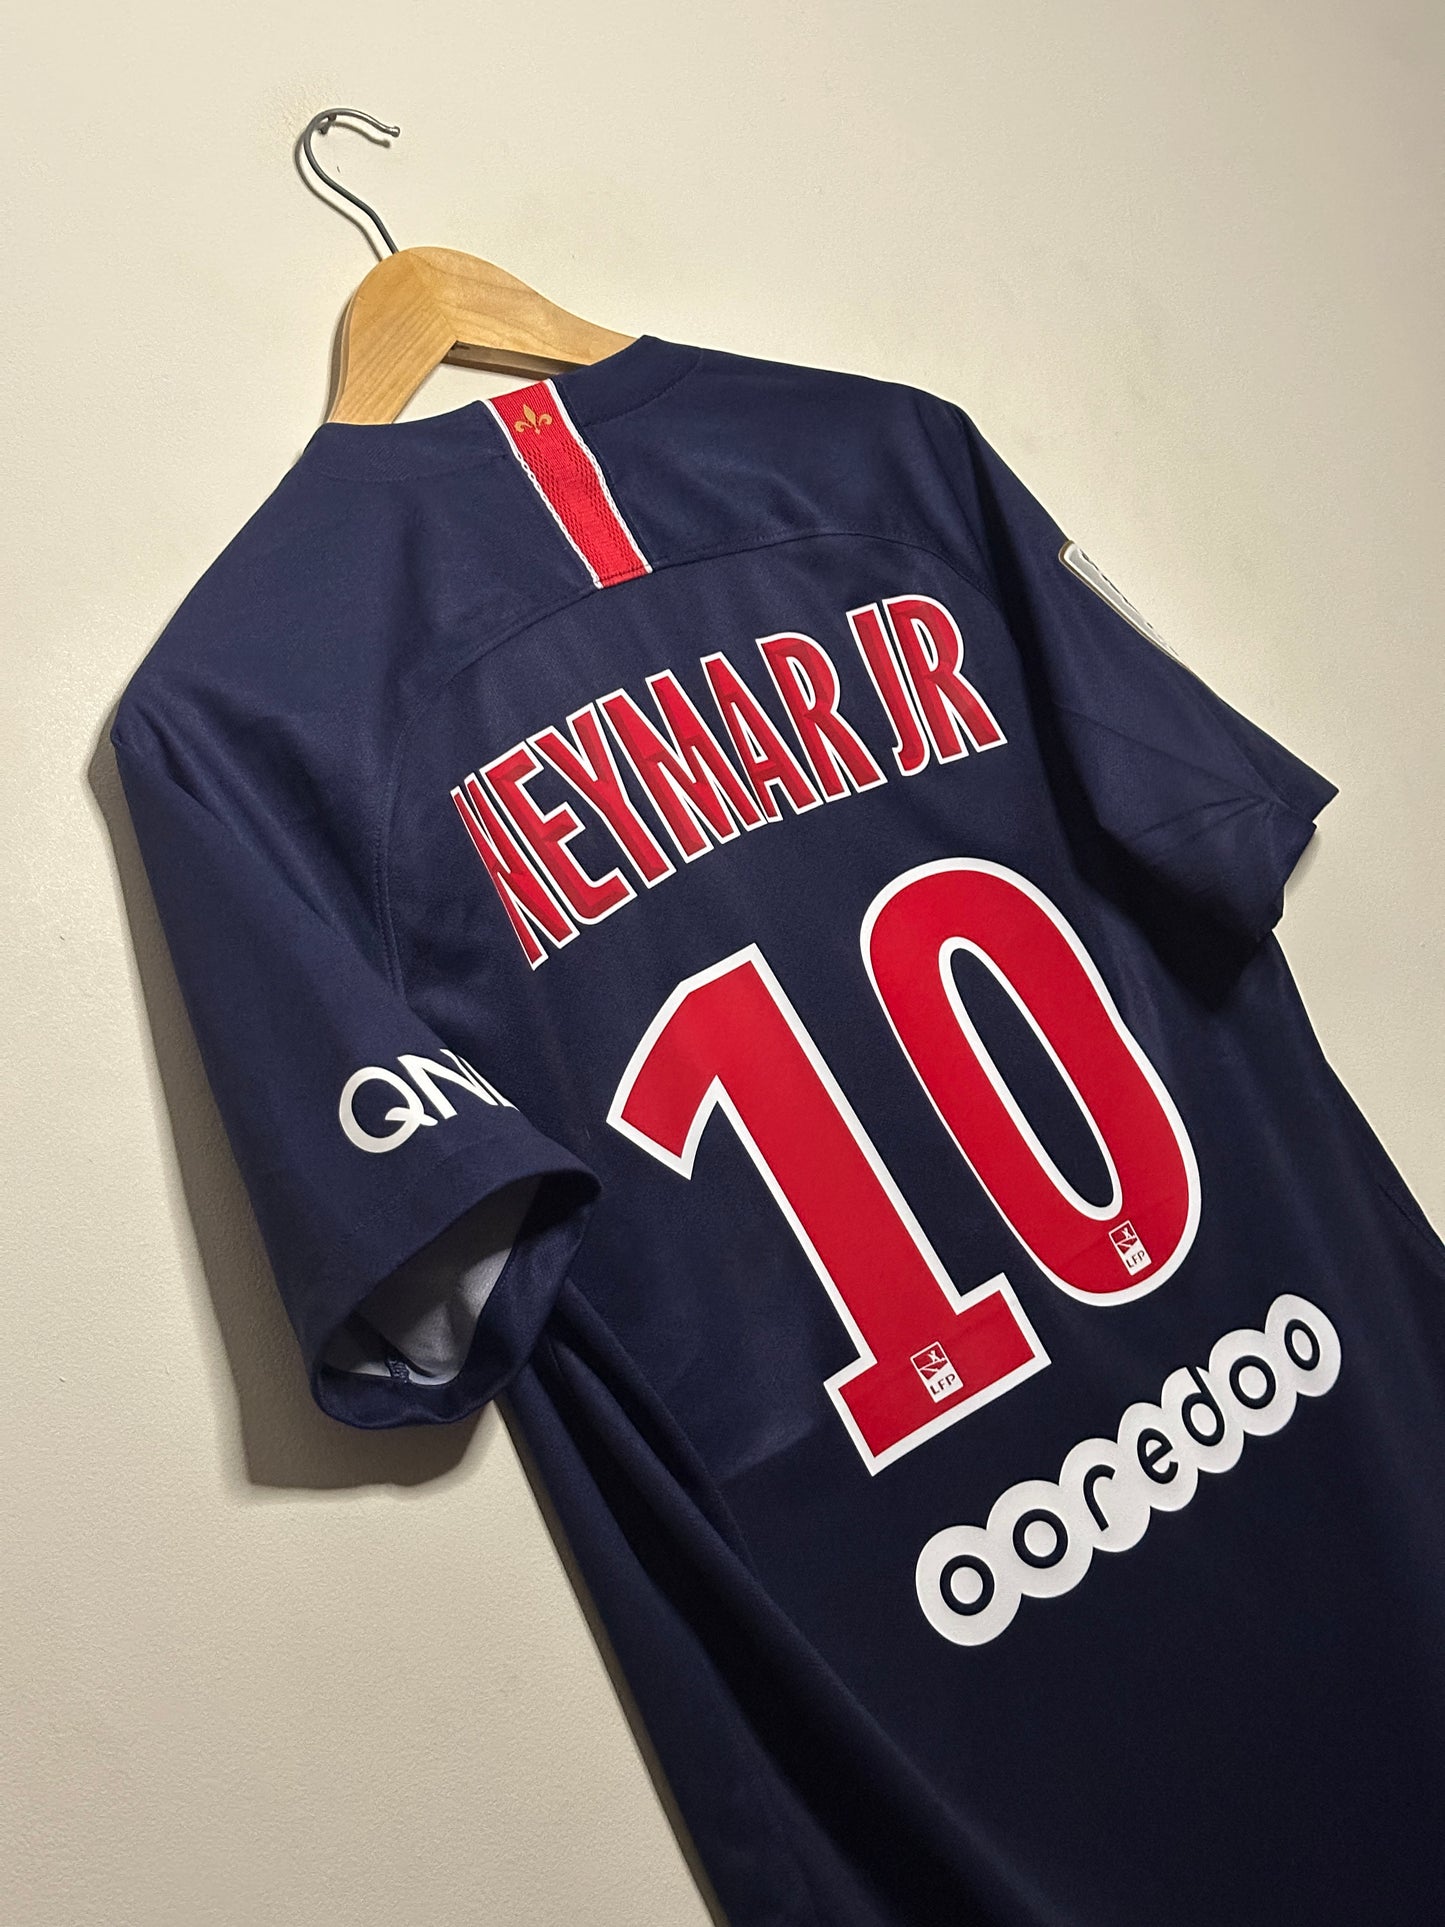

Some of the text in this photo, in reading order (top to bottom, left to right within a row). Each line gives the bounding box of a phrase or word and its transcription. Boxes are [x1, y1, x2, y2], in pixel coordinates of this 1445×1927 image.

[450, 594, 1007, 970] NEYMAR JR
[339, 1048, 519, 1153] QN
[606, 857, 1201, 1476] 10
[1125, 1249, 1146, 1269] LFP
[929, 1373, 956, 1396] LFP
[936, 1316, 1323, 1618] ooredoo
